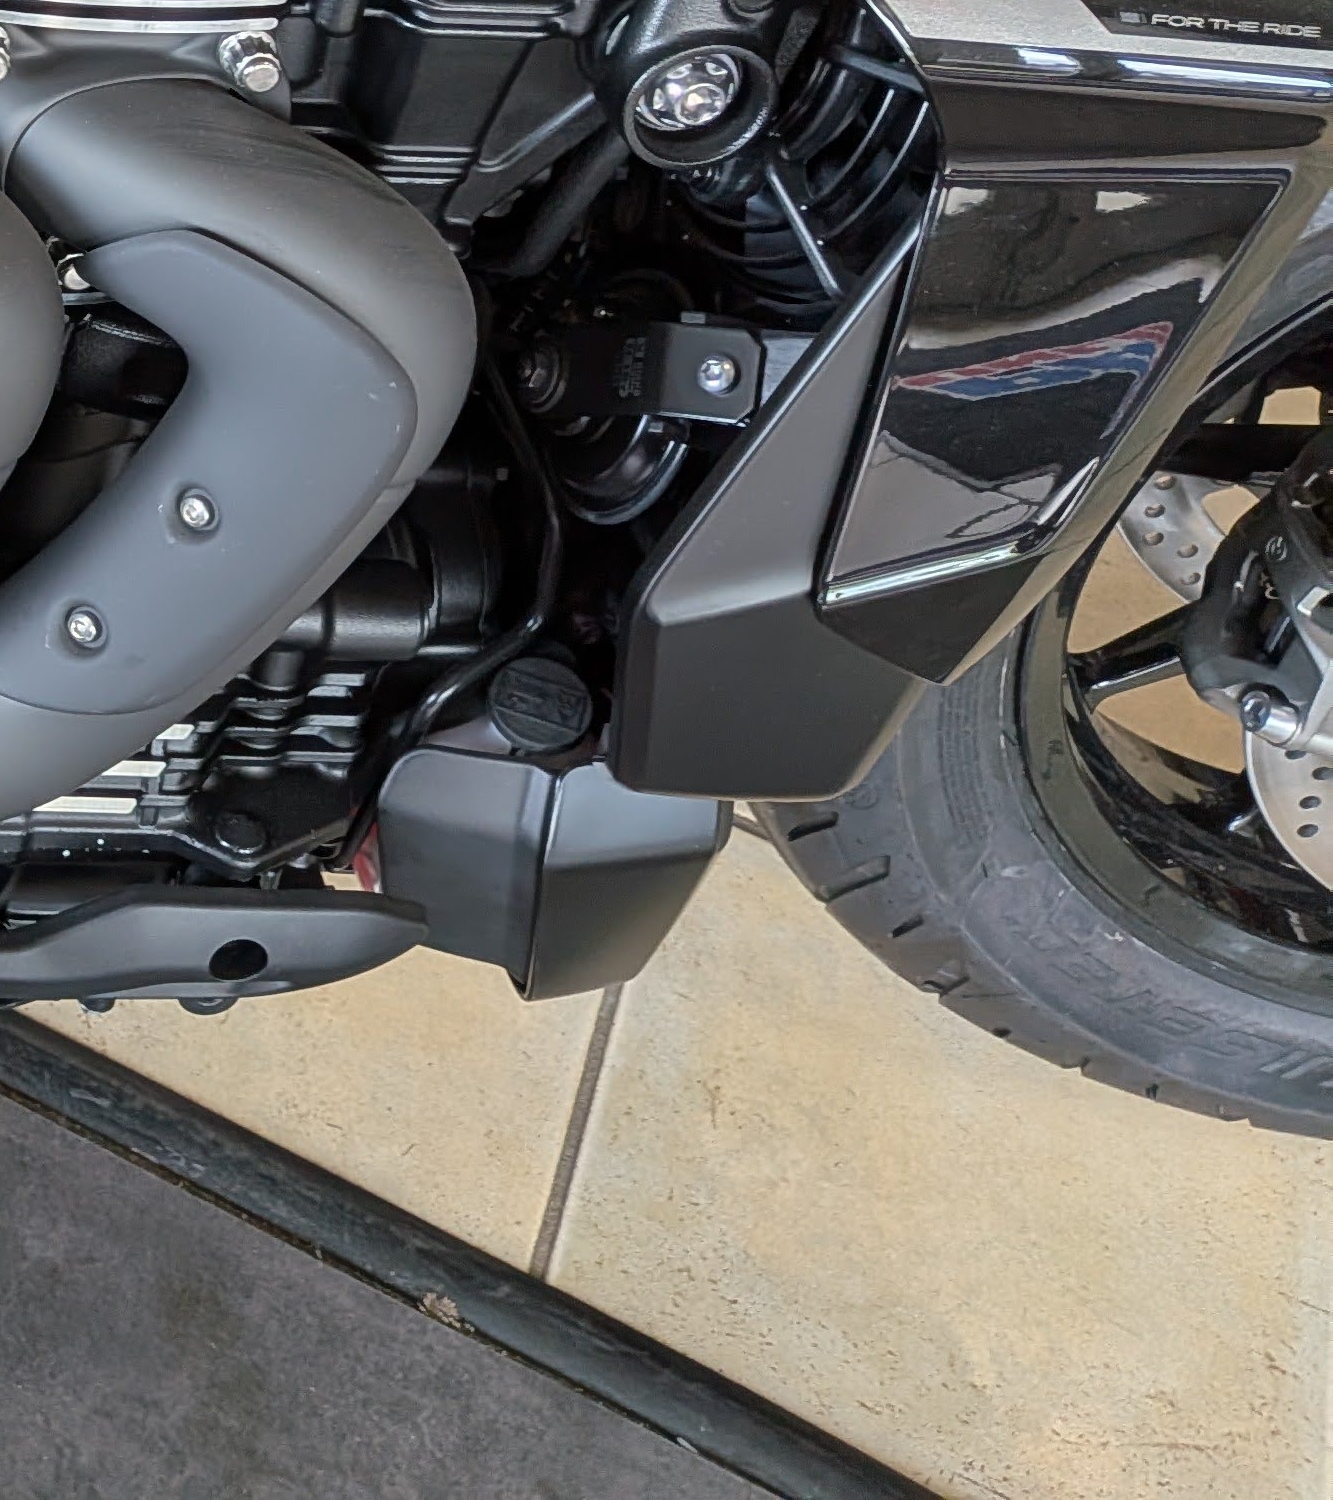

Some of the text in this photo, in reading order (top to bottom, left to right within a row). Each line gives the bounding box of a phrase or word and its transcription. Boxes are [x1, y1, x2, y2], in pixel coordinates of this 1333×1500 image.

[1151, 13, 1322, 38] FOR THE RIDE
